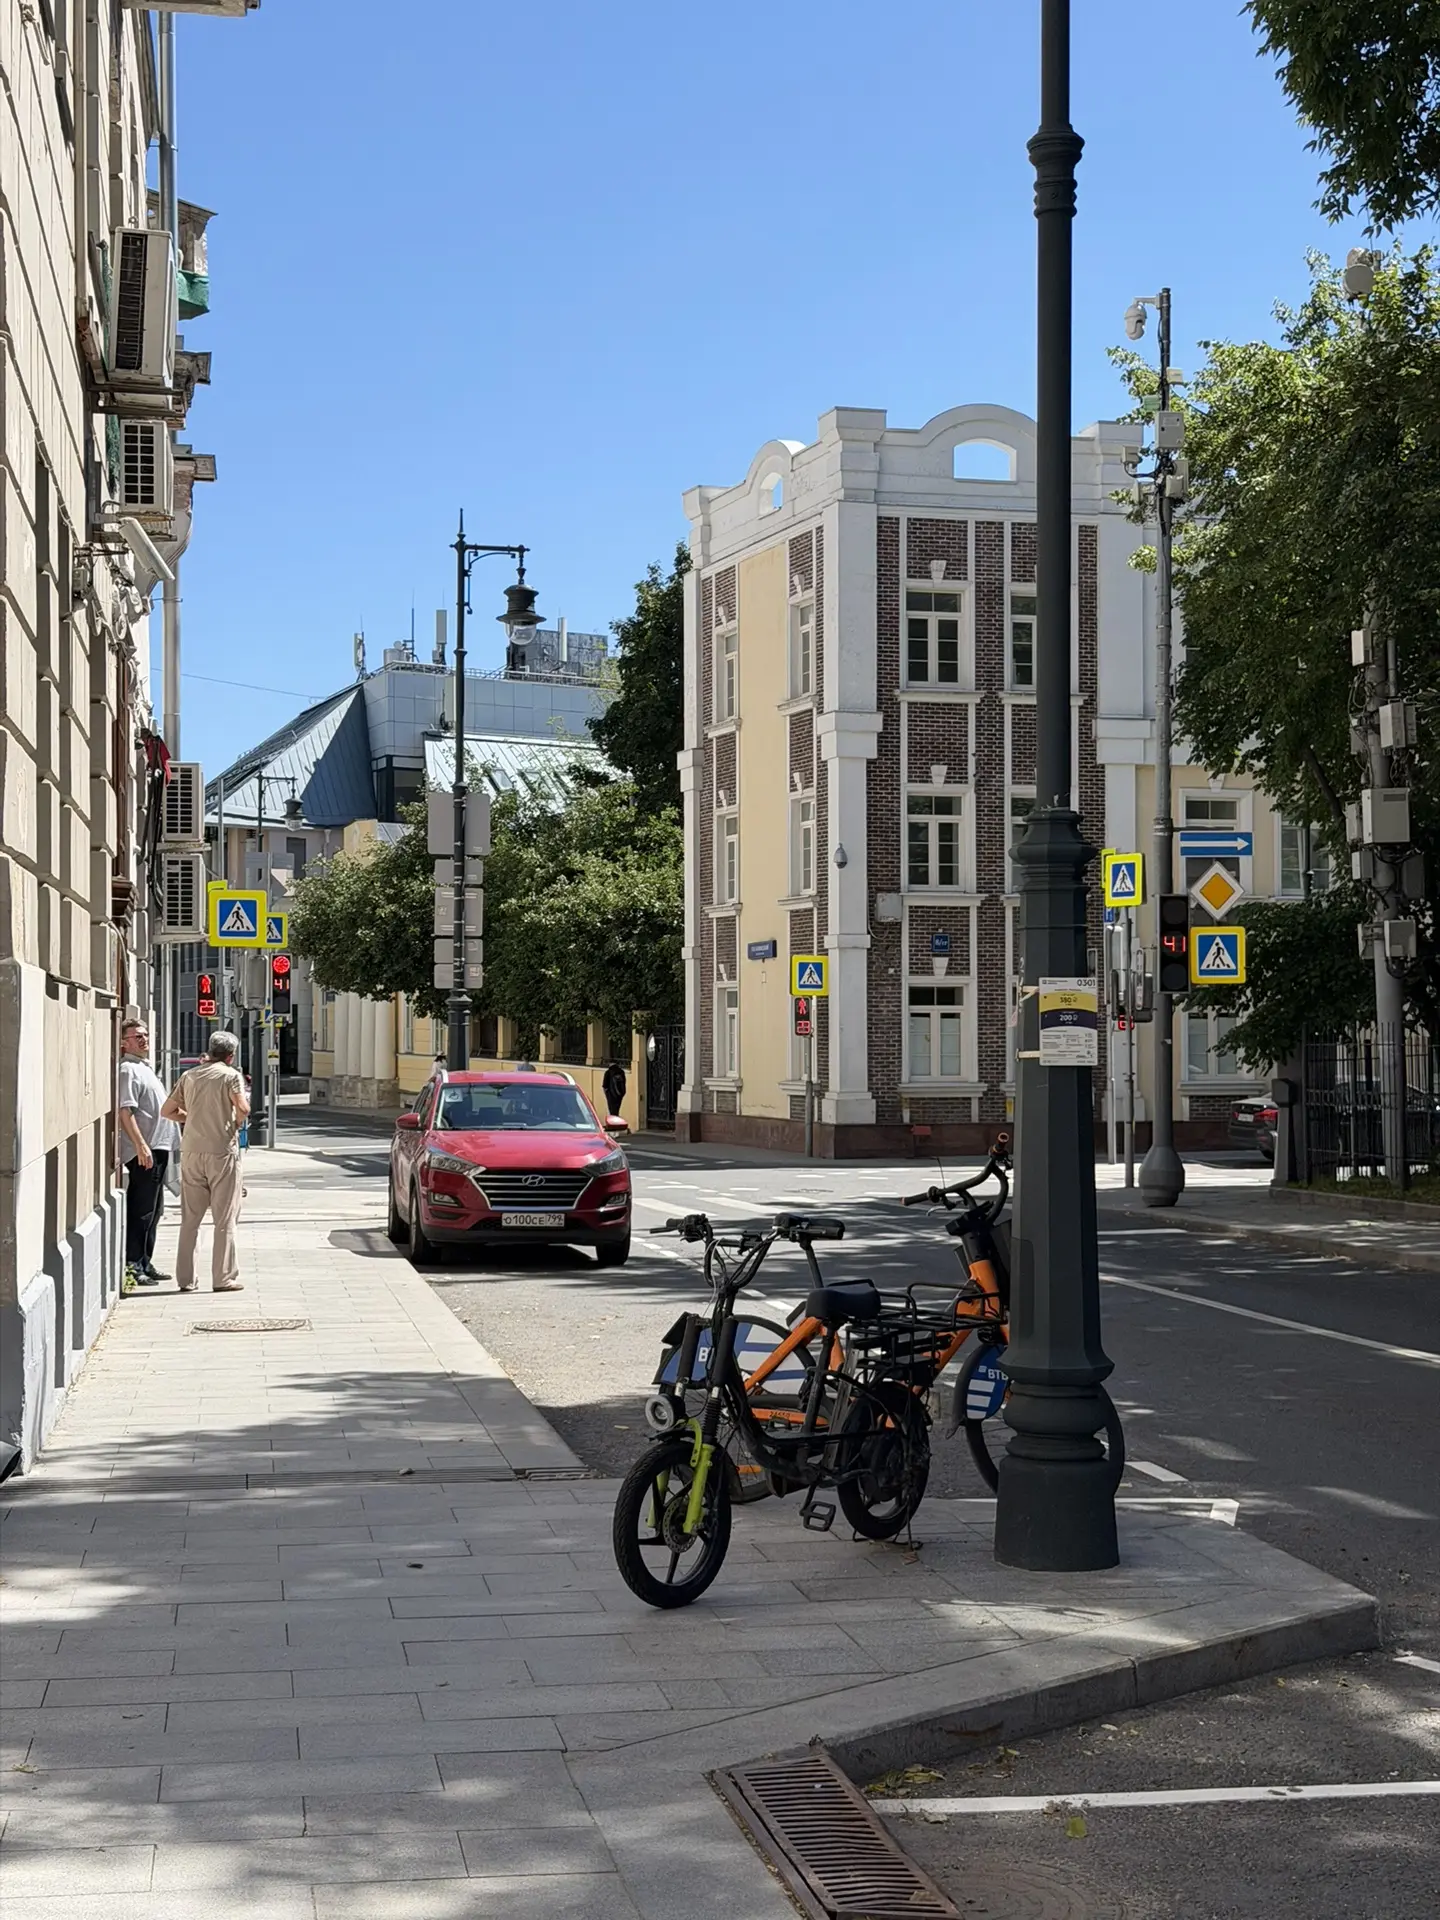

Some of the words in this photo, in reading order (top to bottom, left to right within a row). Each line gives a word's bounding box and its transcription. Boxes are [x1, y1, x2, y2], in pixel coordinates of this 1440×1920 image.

[1164, 936, 1186, 952] 41
[274, 979, 290, 990] 41
[1077, 979, 1096, 987] 0301
[199, 999, 216, 1014] 23
[1060, 1014, 1073, 1022] 200
[547, 1214, 562, 1223] 799
